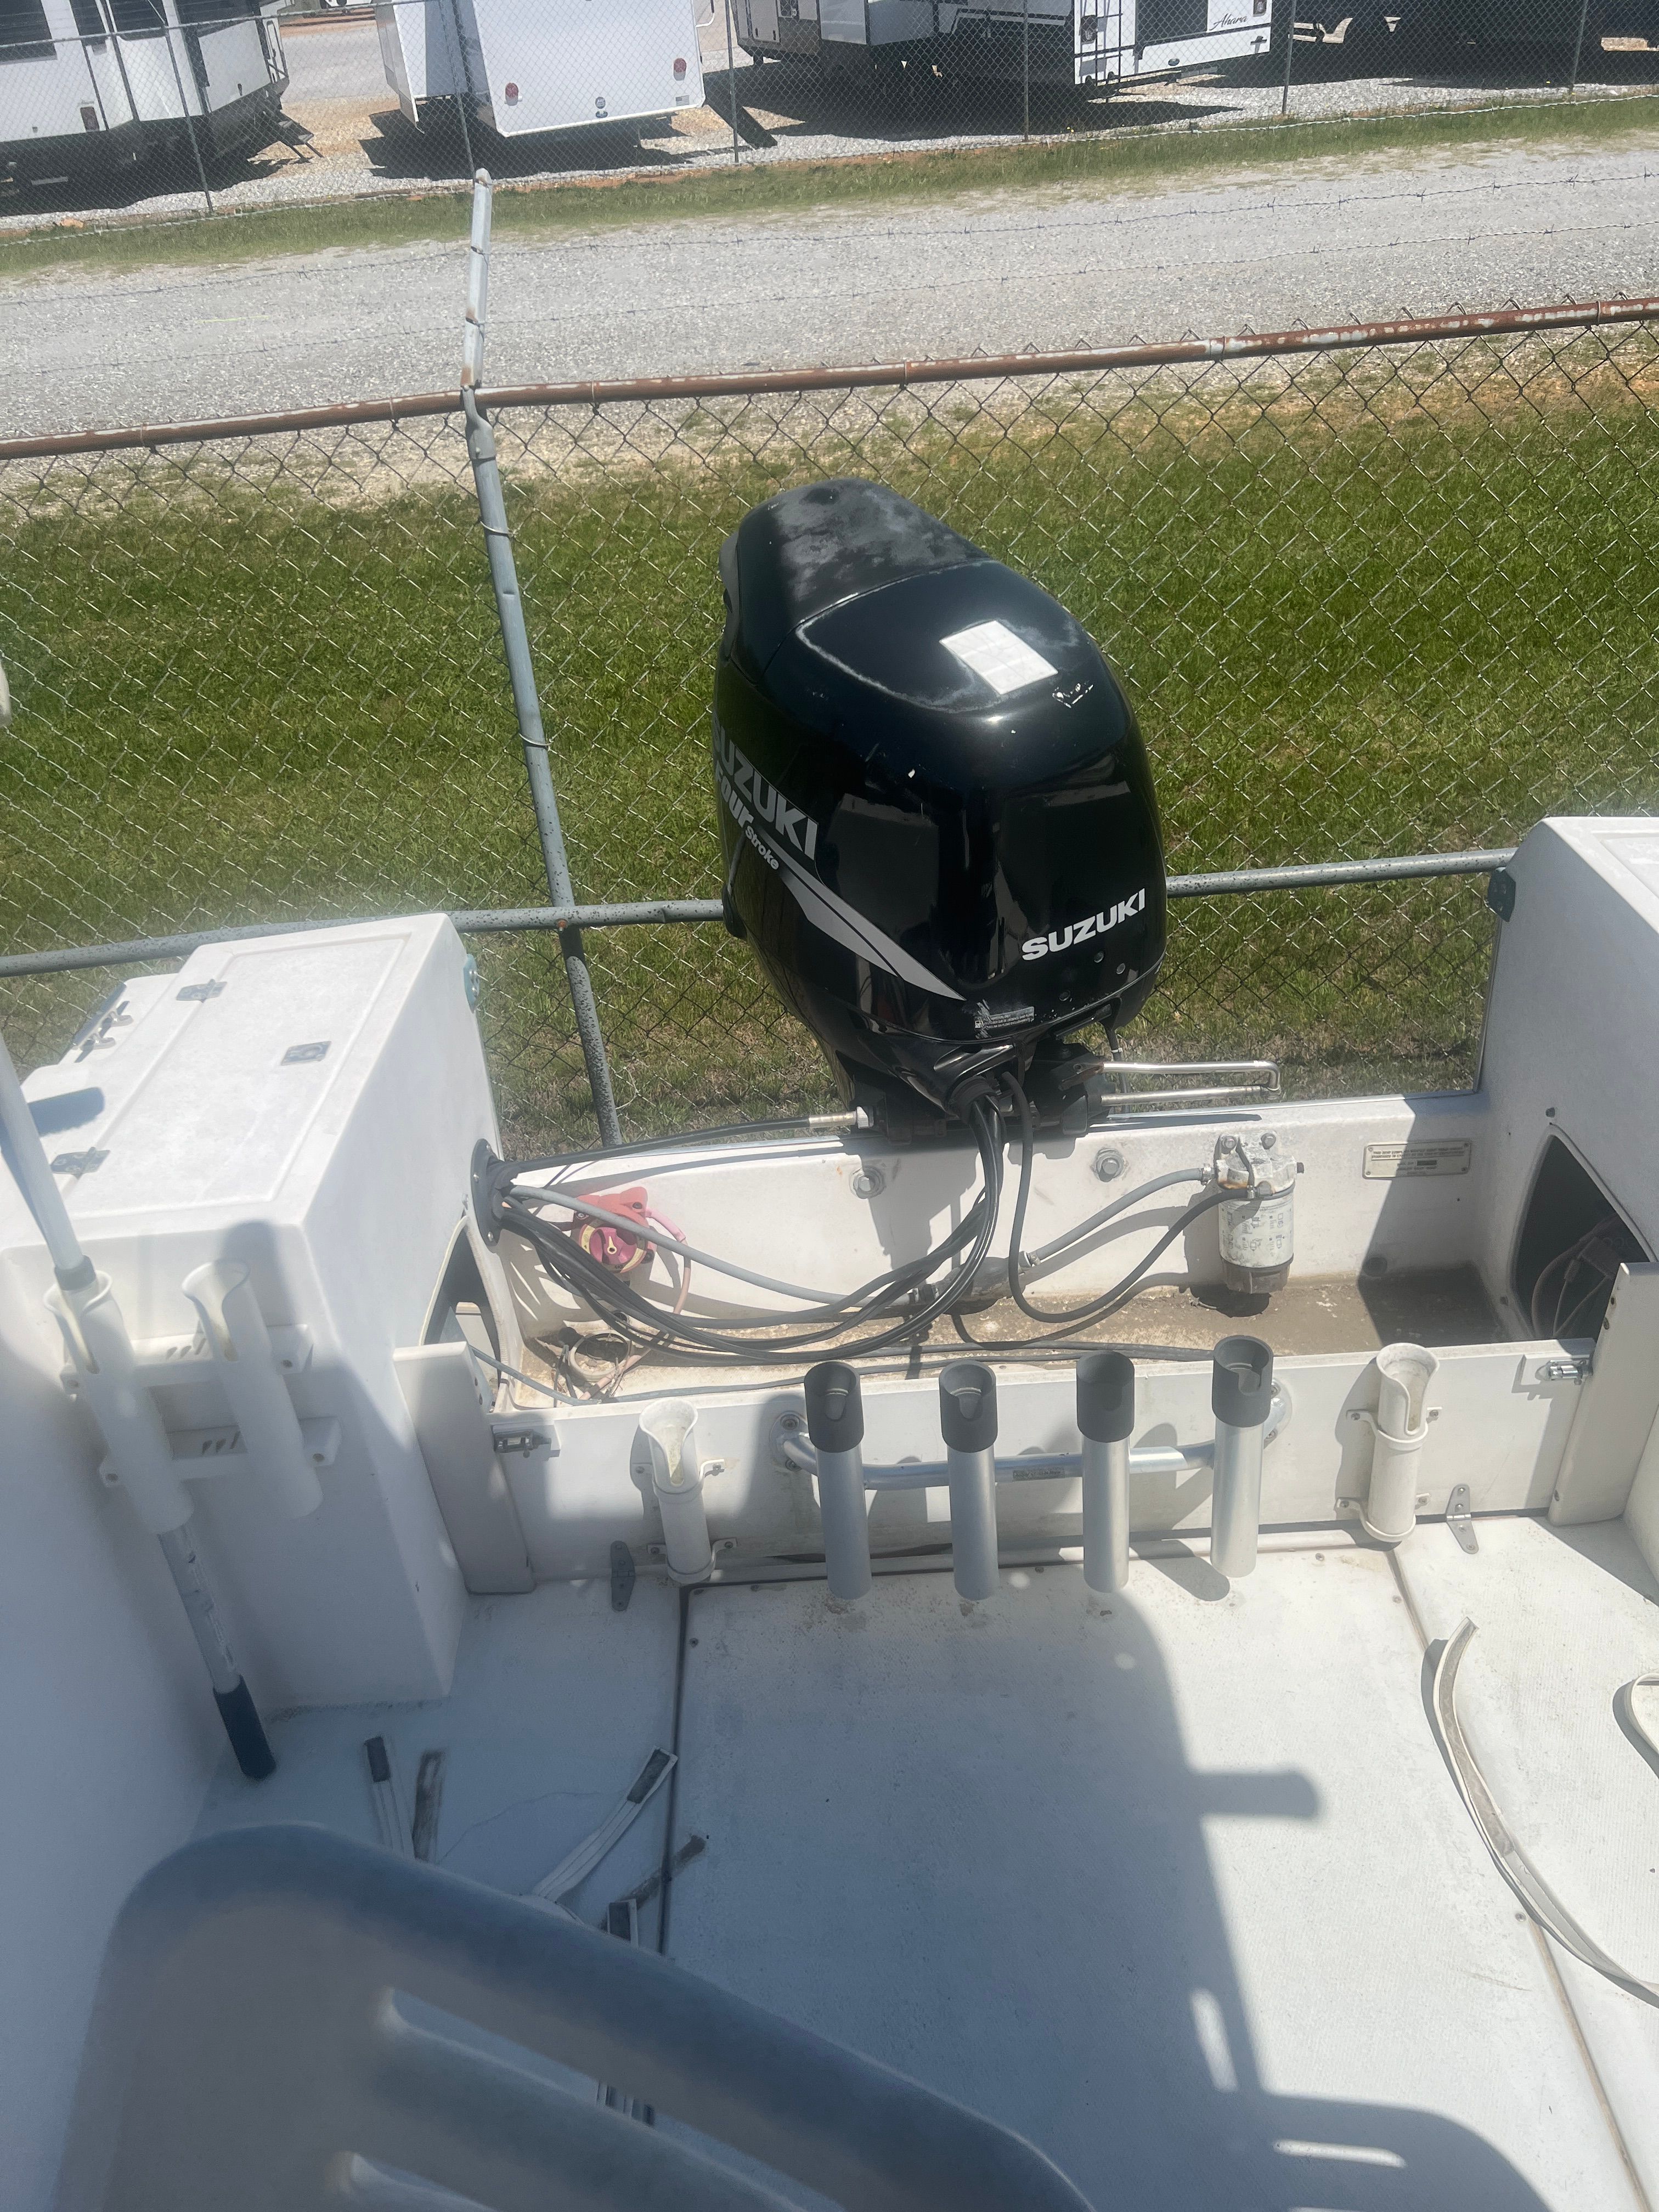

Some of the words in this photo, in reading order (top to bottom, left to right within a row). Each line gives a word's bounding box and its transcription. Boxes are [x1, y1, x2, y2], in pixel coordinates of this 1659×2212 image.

[1209, 13, 1248, 31] Ahara
[744, 825, 780, 870] Stroke
[1022, 888, 1146, 961] SUZUKI
